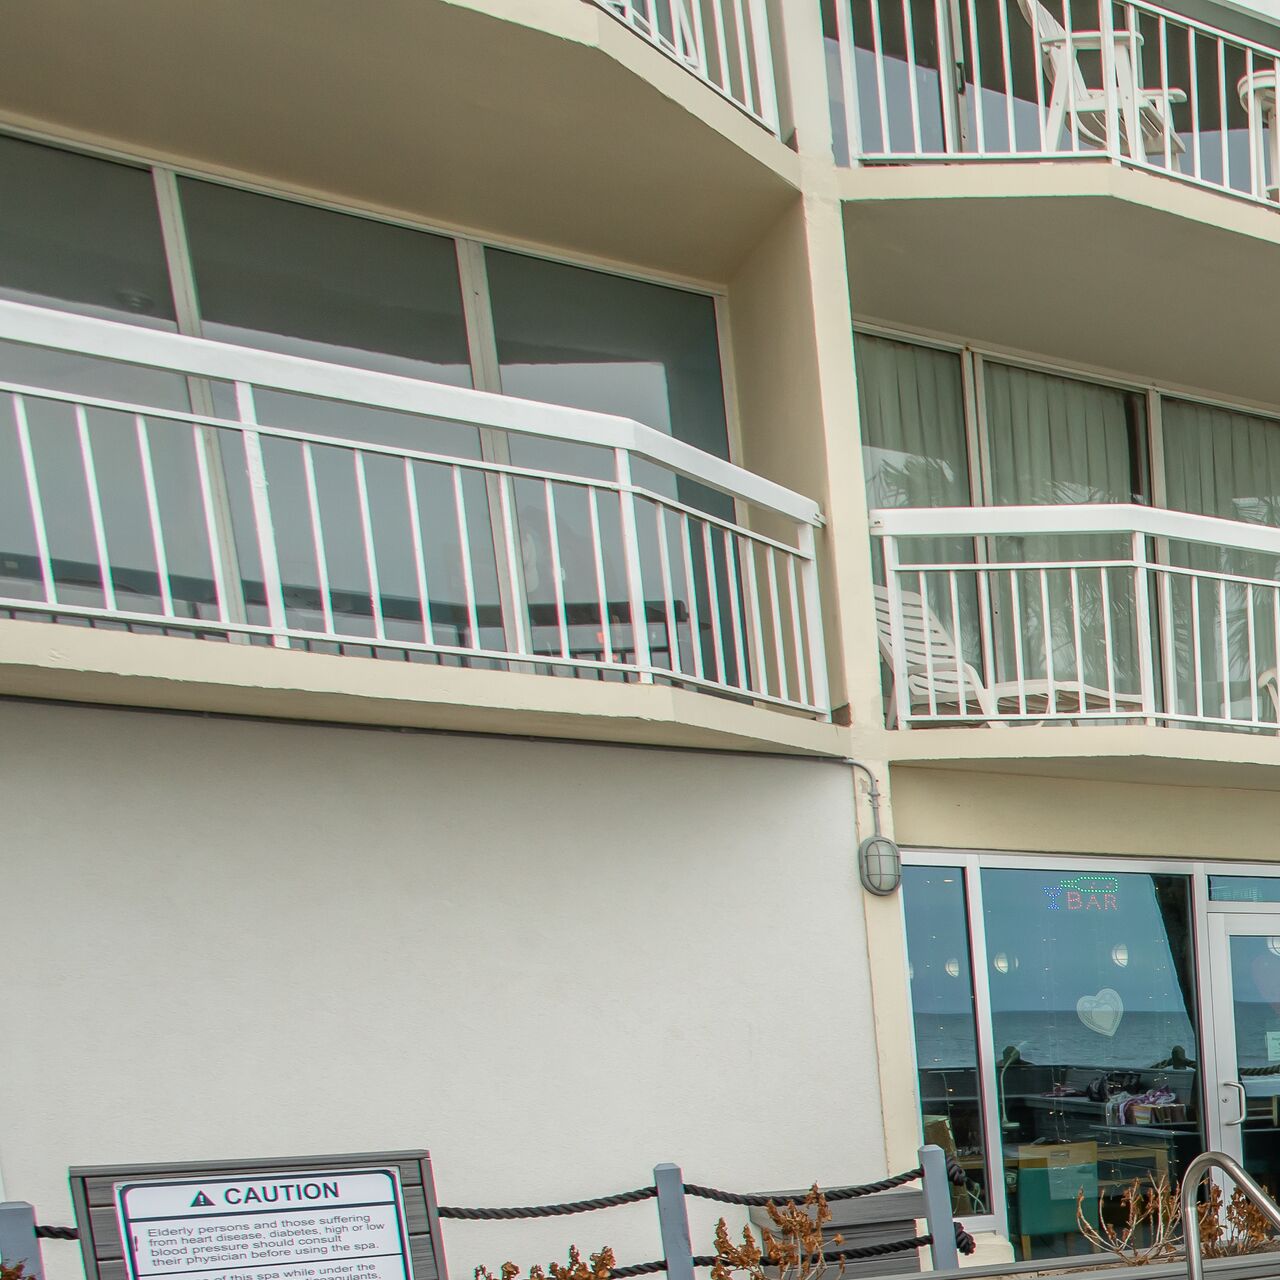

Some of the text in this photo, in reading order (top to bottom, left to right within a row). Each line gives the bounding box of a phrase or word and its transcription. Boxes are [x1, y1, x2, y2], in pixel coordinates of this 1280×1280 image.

[1067, 891, 1117, 911] BAR
[224, 1181, 340, 1206] CAUTION
[147, 1215, 371, 1238] Elderly persons and those suffering
[148, 1239, 177, 1248] from
[181, 1236, 213, 1245] heart
[325, 1225, 349, 1235] high
[366, 1223, 385, 1231] low
[150, 1235, 342, 1257] blood pressure should consult
[152, 1258, 183, 1267] their
[185, 1253, 247, 1266] physician
[250, 1249, 292, 1259] before
[293, 1246, 328, 1255] using
[331, 1244, 351, 1252] the
[283, 1269, 315, 1278] while
[319, 1266, 354, 1275] under
[356, 1263, 376, 1272] the
